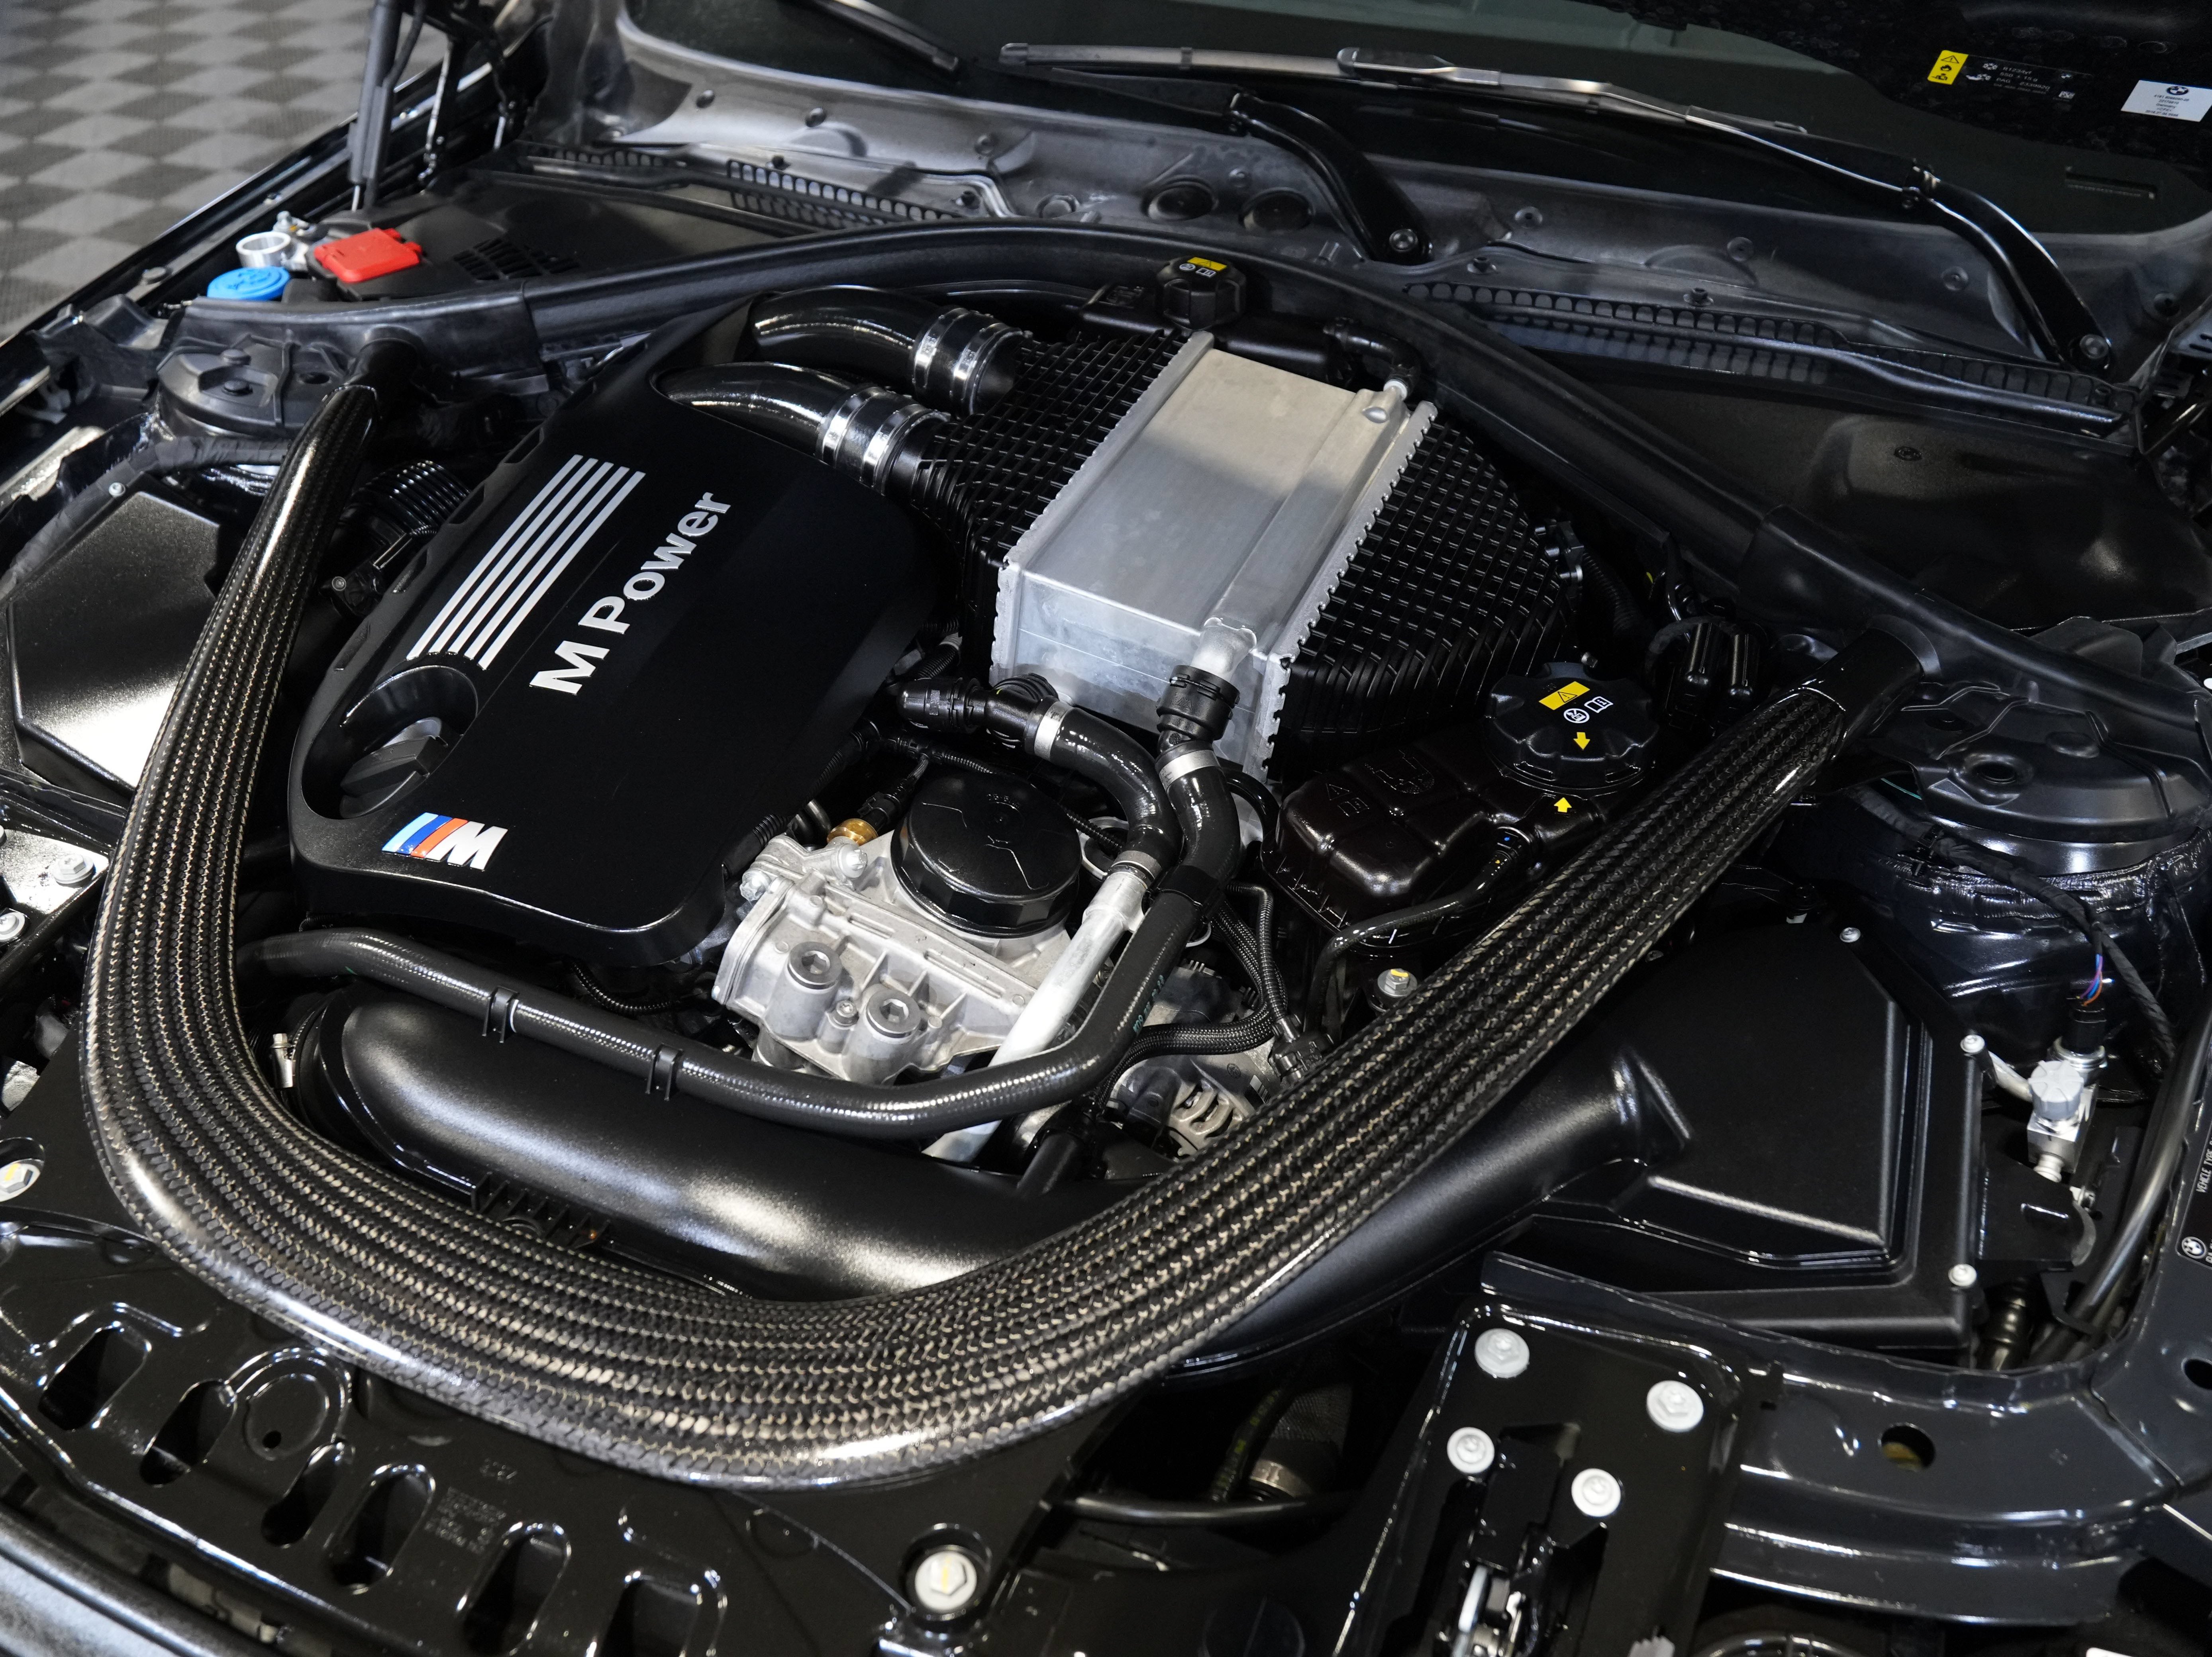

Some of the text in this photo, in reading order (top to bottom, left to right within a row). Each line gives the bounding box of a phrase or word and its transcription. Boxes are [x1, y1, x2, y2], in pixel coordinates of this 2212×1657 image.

[529, 492, 731, 695] M Power
[424, 821, 509, 871] M
[2196, 1167, 2212, 1193] VEHICLE
